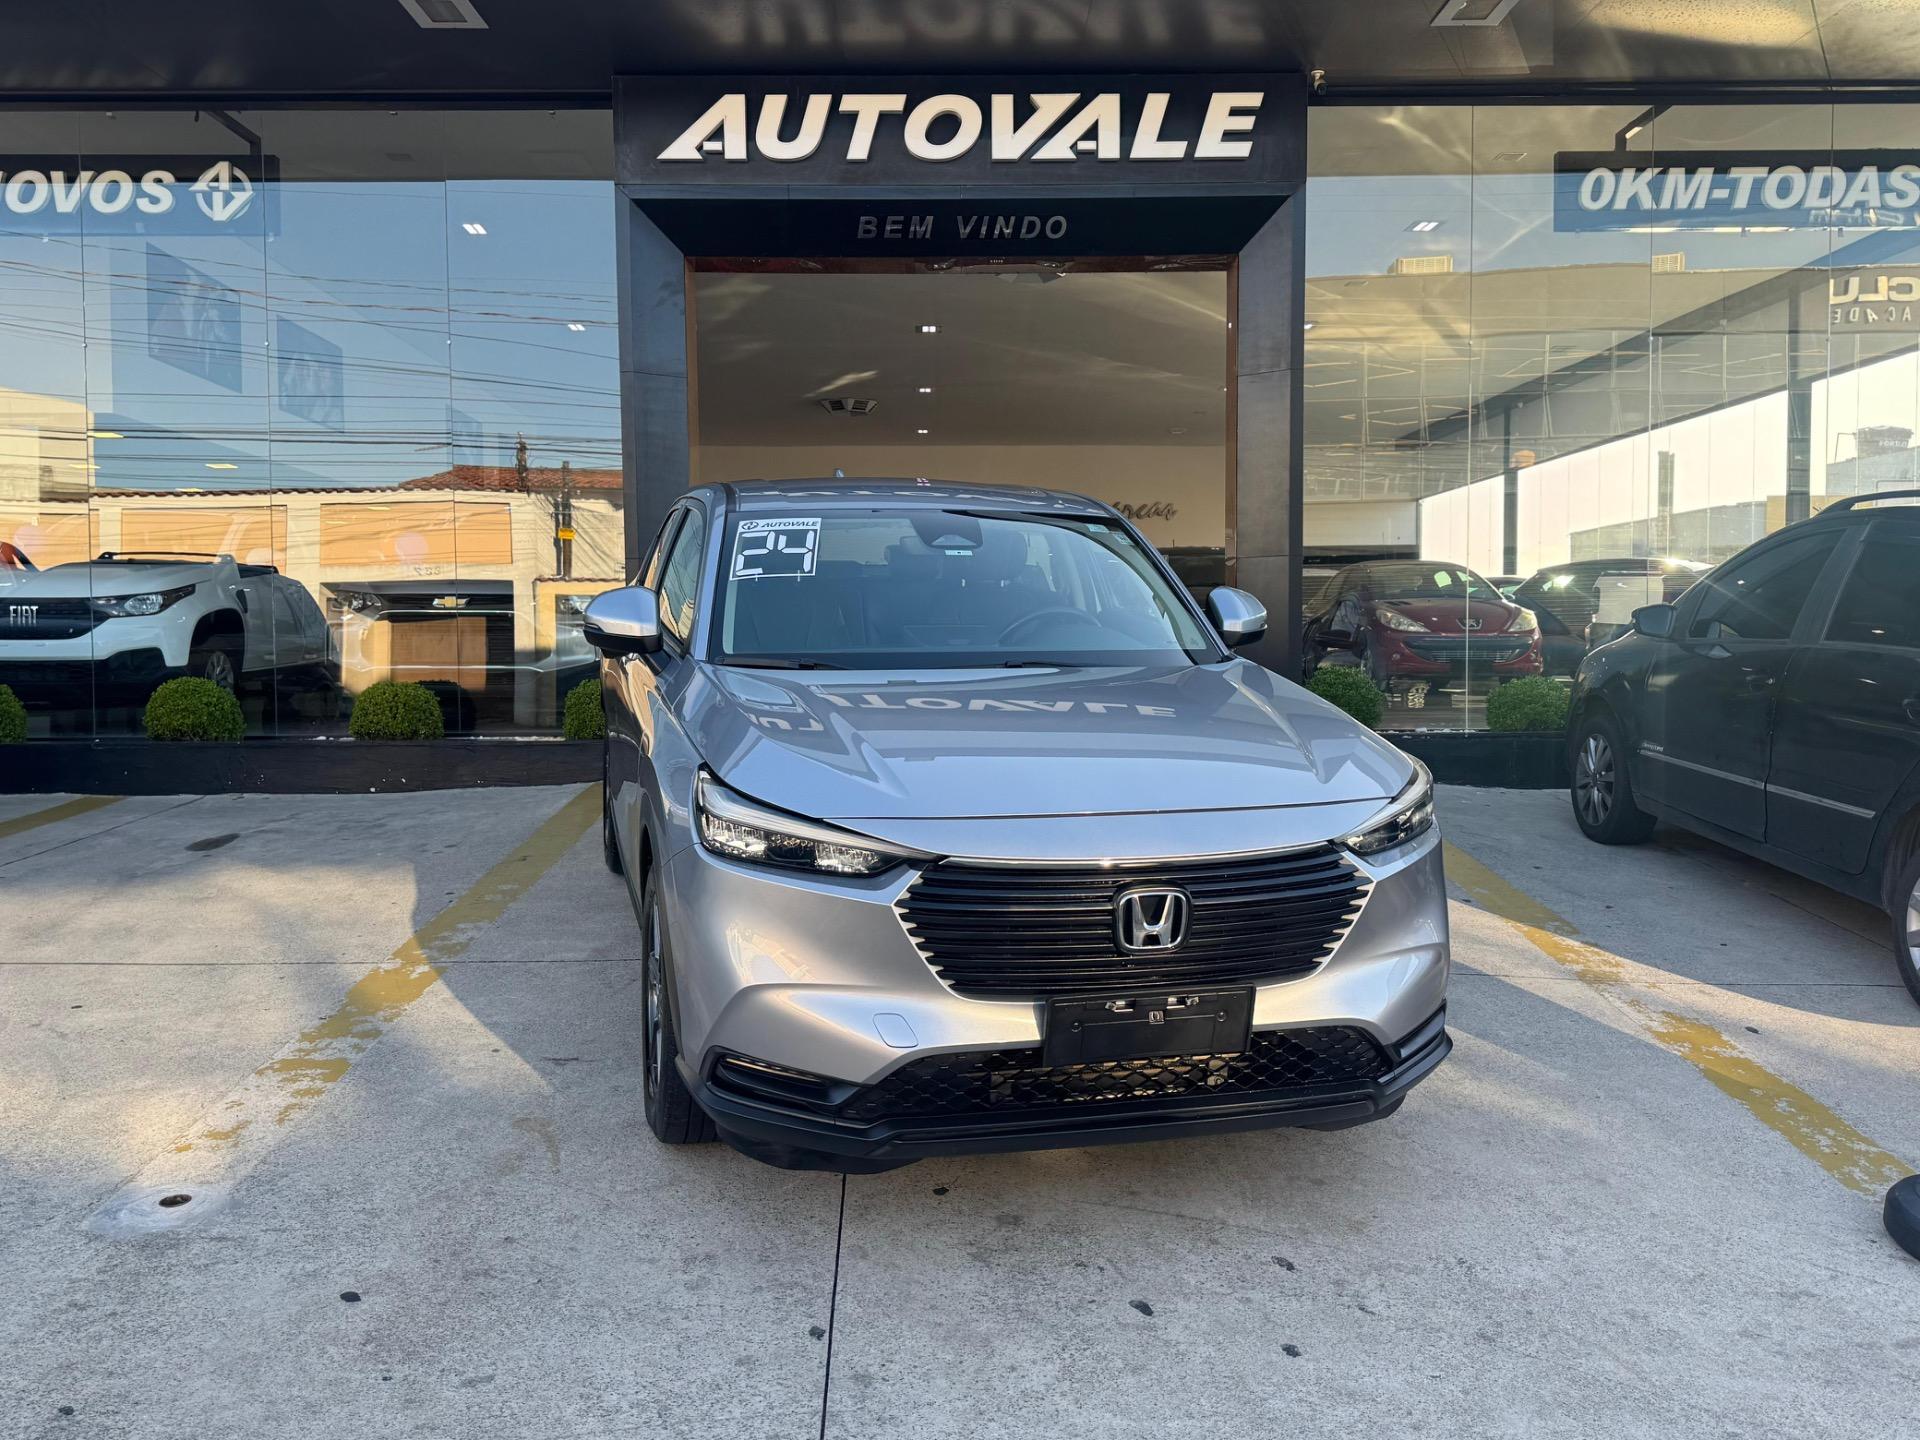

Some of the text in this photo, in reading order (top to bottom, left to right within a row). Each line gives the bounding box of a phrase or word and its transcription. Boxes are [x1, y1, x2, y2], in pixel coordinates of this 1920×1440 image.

[657, 92, 1264, 163] AUTOVALE
[0, 169, 176, 214] OVOS
[857, 215, 1067, 239] BEM VINDO
[760, 521, 818, 529] AUTOVALE
[735, 531, 815, 576] 24
[9, 605, 39, 627] FIAT
